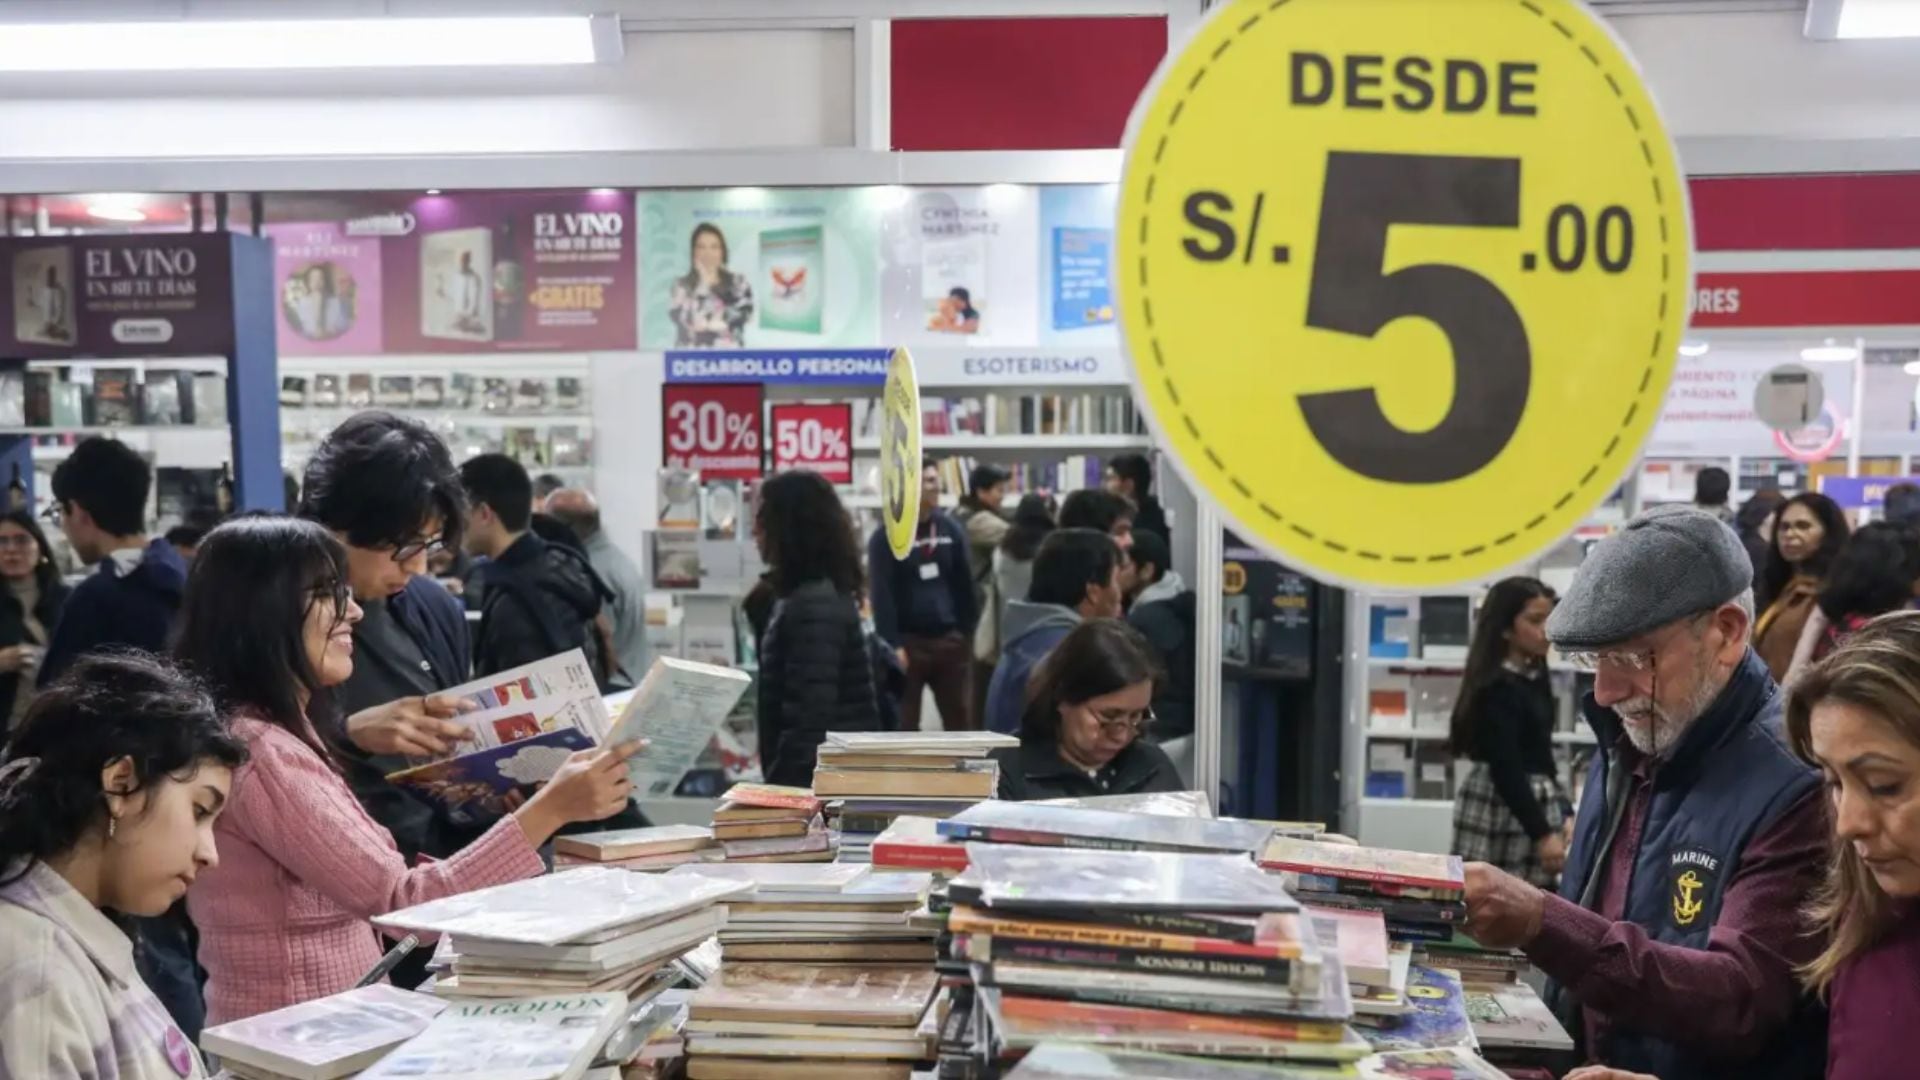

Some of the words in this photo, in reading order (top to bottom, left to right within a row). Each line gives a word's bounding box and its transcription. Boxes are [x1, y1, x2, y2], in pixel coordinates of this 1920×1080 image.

[1289, 51, 1539, 117] DESDE
[534, 213, 563, 237] EL
[563, 212, 623, 237] VINO
[86, 249, 121, 277] EL
[122, 248, 197, 276] VINO
[87, 281, 109, 297] EN
[538, 285, 604, 309] GRATIS
[1181, 190, 1291, 265] S/.
[1294, 150, 1532, 486] 5
[671, 358, 793, 377] DESARROLLO
[963, 357, 1098, 376] ESOTERISMO
[669, 401, 758, 452] 30%
[776, 418, 848, 460] 50%
[1672, 850, 1718, 870] MARINE
